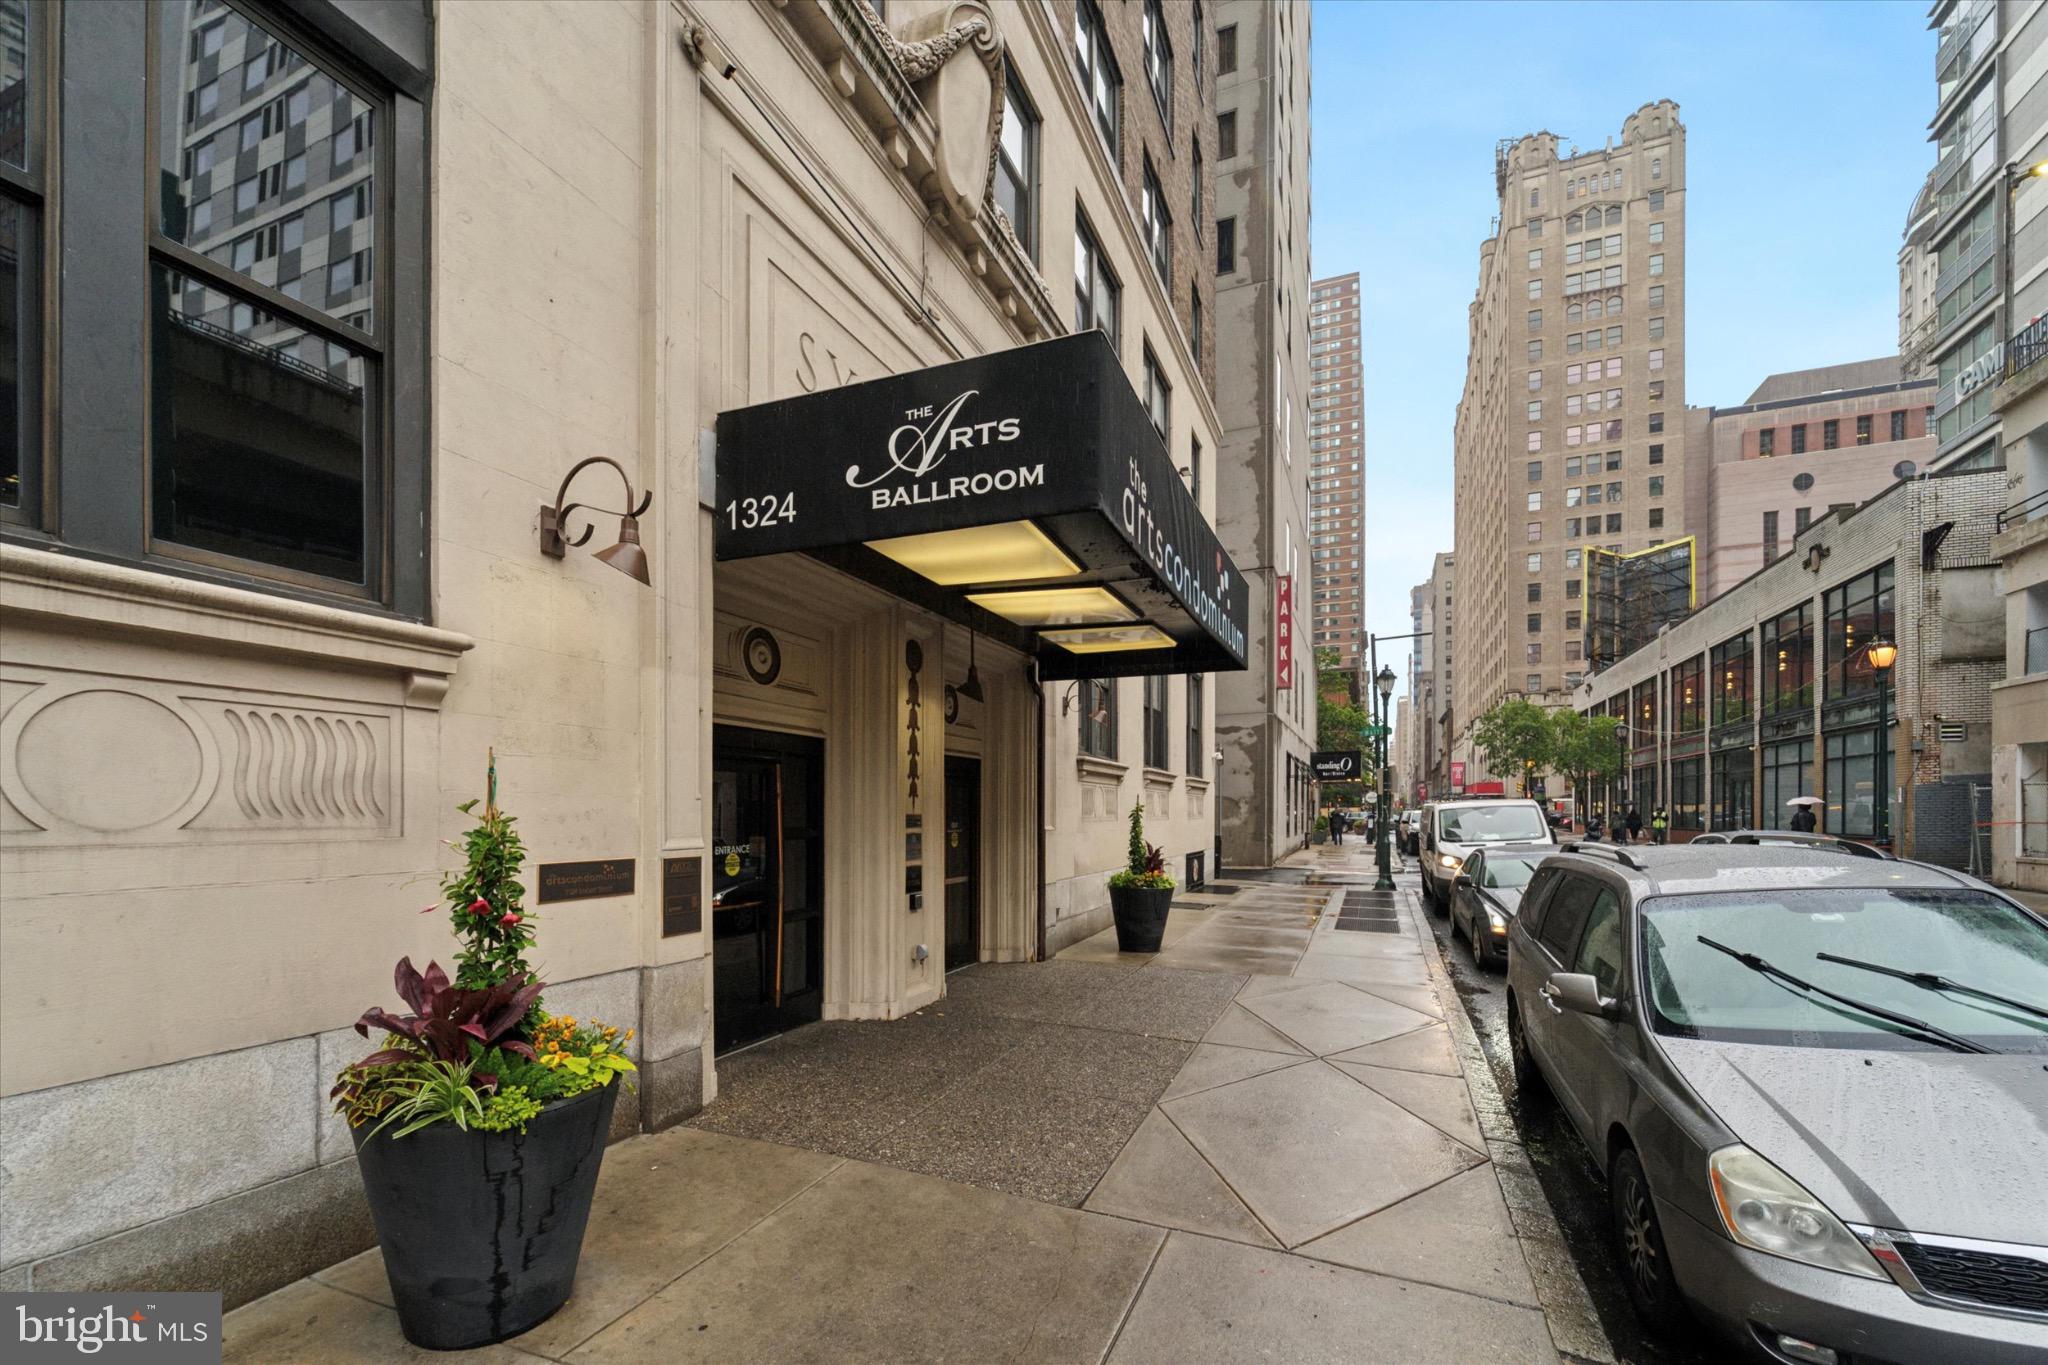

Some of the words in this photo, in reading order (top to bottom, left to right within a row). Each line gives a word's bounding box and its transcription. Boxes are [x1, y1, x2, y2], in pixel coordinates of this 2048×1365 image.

[905, 405, 933, 421] THE
[846, 389, 1021, 488] ARTS
[872, 463, 1044, 509] BALLROOM
[1129, 456, 1147, 503] the
[726, 491, 797, 530] 1324
[1280, 580, 1289, 660] PARK
[714, 844, 751, 855] ENTRANCE
